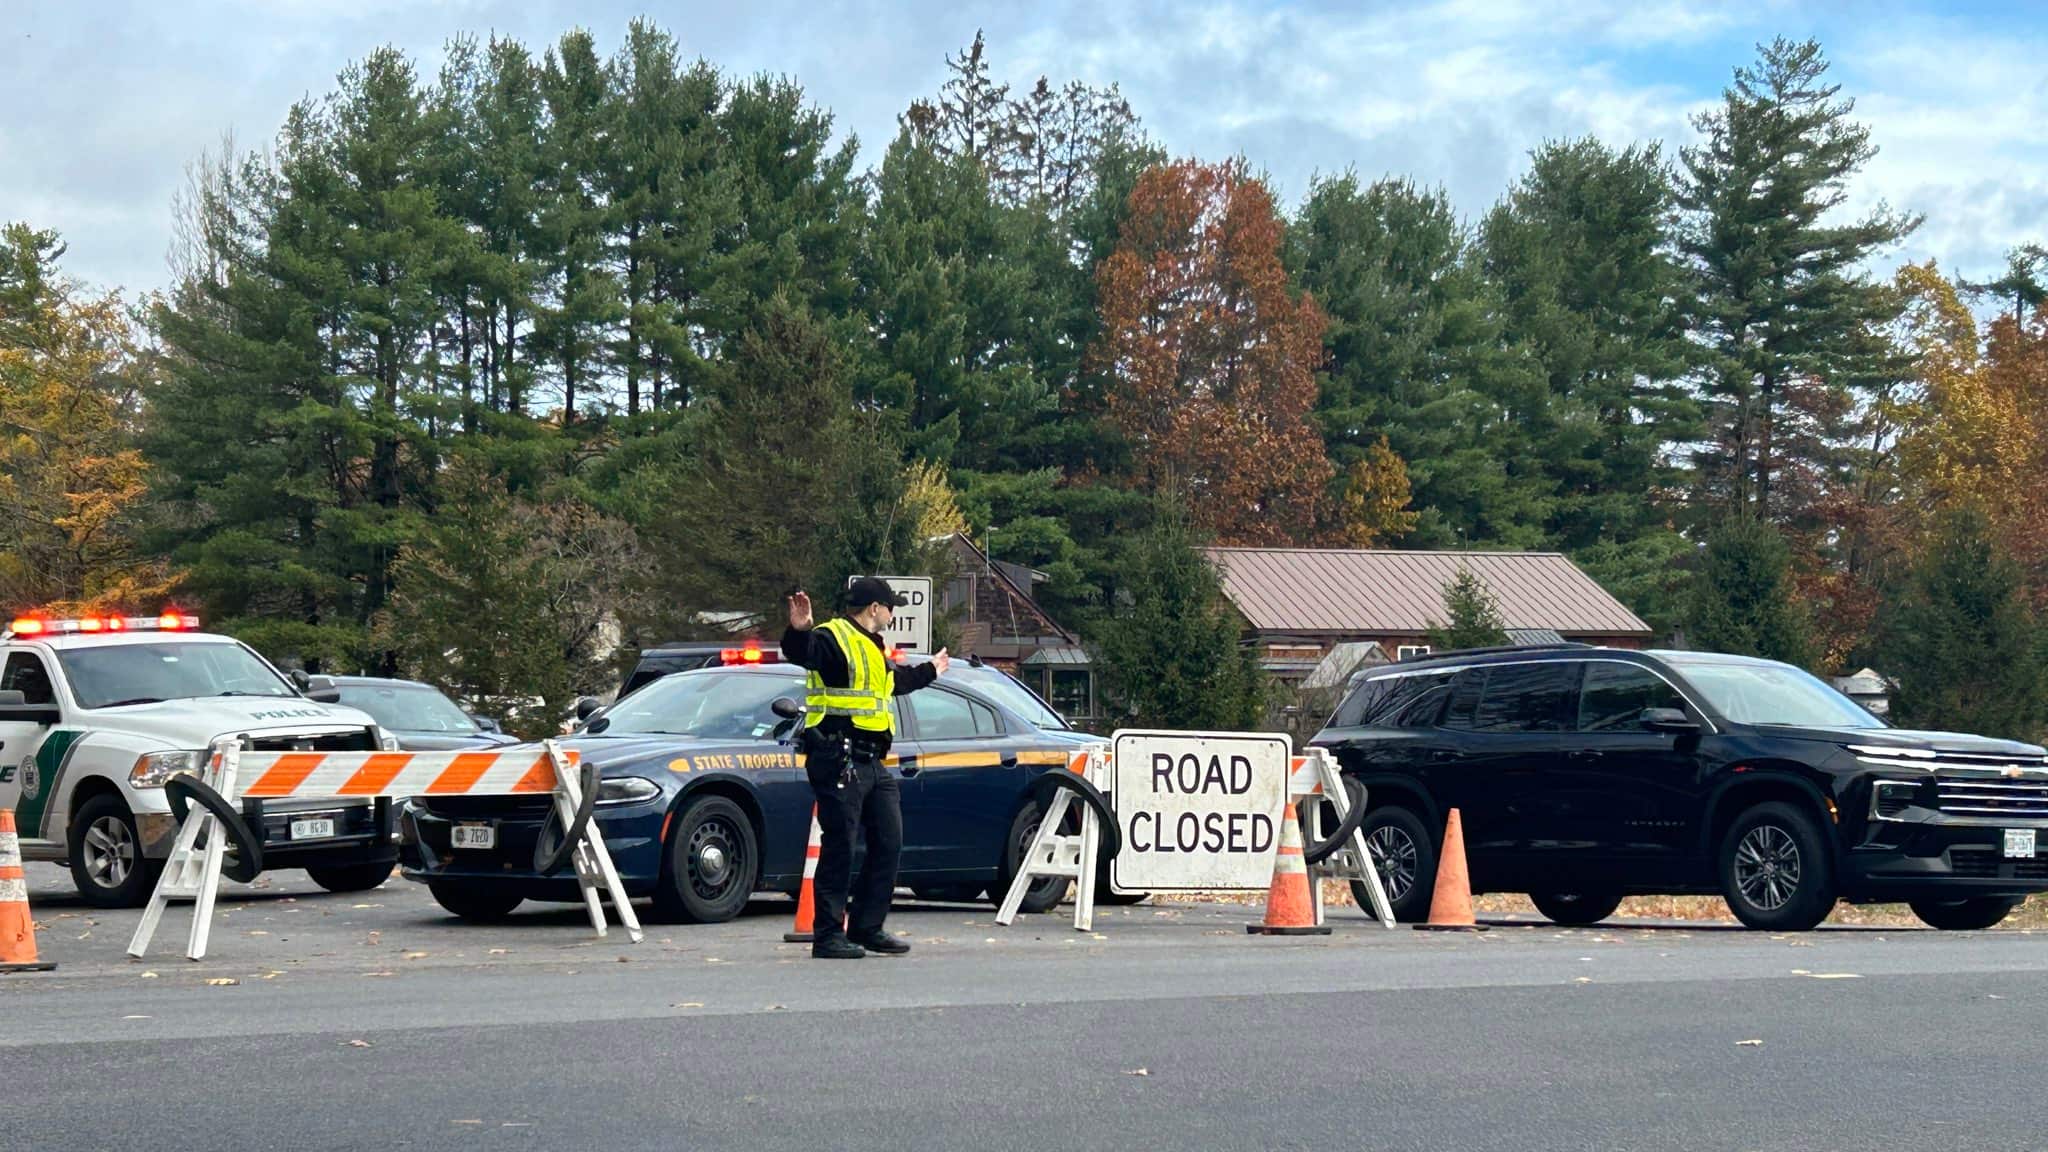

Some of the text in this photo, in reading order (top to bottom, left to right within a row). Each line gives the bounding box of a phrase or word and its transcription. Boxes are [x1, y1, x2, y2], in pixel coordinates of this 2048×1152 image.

[883, 616, 915, 631] MIT
[693, 754, 793, 771] STATE TROOPER
[1152, 753, 1252, 795] ROAD
[1129, 811, 1274, 852] CLOSED
